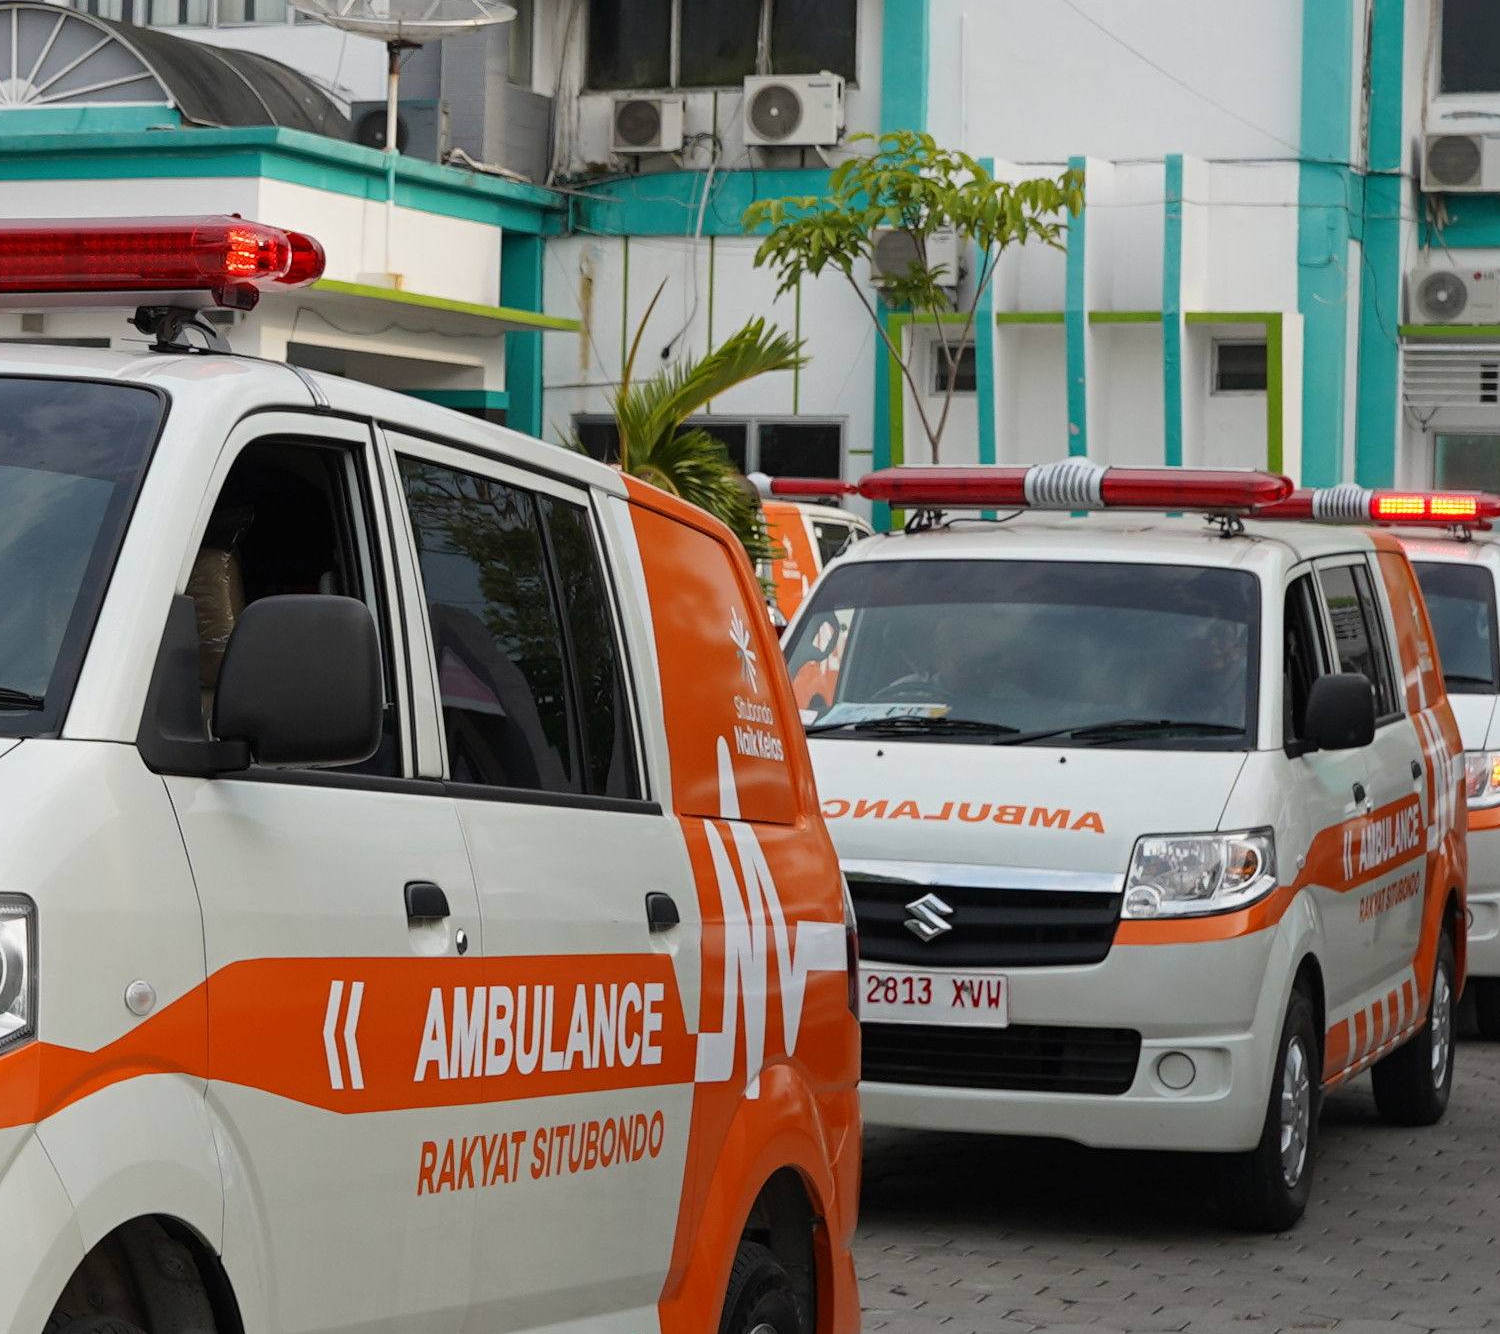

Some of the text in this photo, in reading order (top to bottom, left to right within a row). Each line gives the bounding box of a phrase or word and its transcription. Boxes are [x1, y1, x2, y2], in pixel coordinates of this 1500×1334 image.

[733, 695, 774, 726] Situbondo
[733, 725, 785, 762] Naik Kelas
[1358, 802, 1420, 874] AMBULANCE
[1358, 887, 1386, 925] RAKYAT
[866, 975, 1002, 1009] 2813 XVW
[412, 981, 665, 1083] AMBULANCE
[416, 1109, 665, 1197] RAKYAT SITUBONDO
